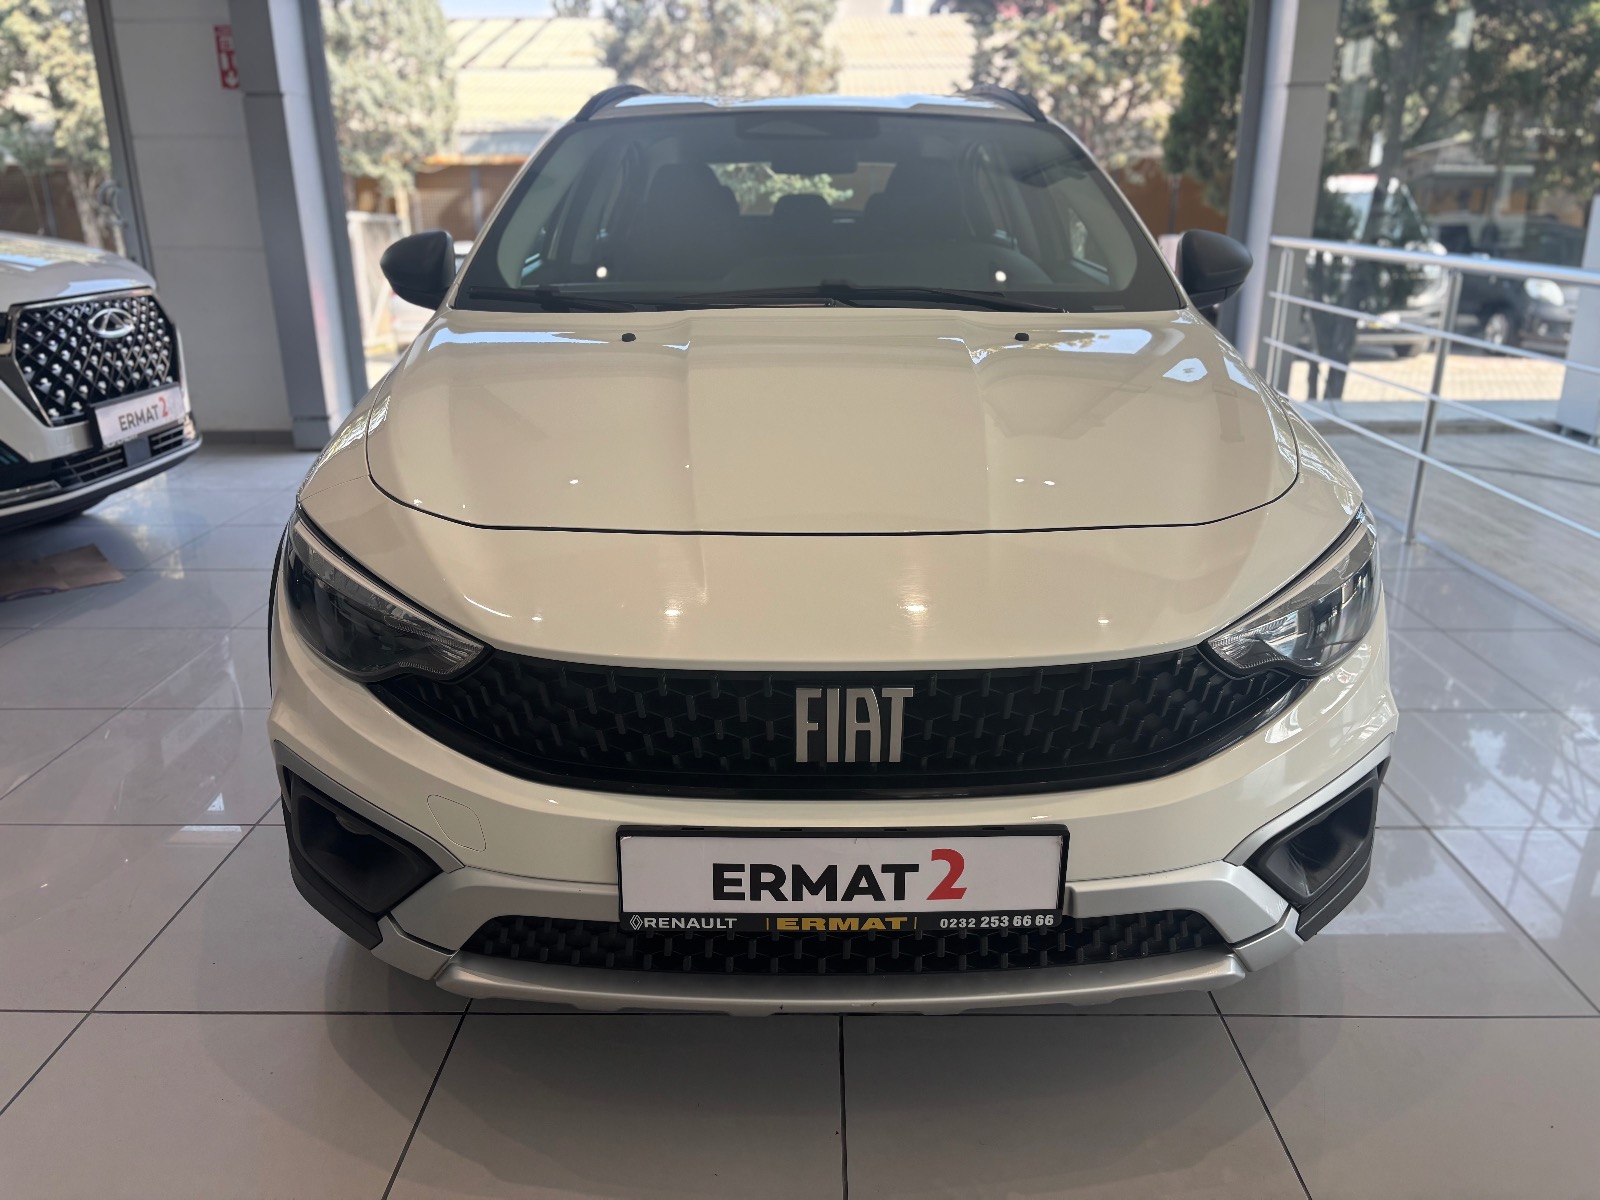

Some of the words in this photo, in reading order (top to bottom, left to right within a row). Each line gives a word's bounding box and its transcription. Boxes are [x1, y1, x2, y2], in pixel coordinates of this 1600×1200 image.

[118, 404, 159, 432] ERMAT
[158, 396, 169, 418] 2
[795, 687, 914, 763] FIAT
[712, 863, 919, 901] ERMAT
[926, 848, 968, 900] 2
[643, 917, 737, 930] RENAULT
[777, 916, 907, 931] ERMAT
[940, 917, 976, 929] 0232
[979, 915, 1010, 928] 253
[1012, 914, 1032, 927] 66
[1035, 914, 1054, 926] 66
